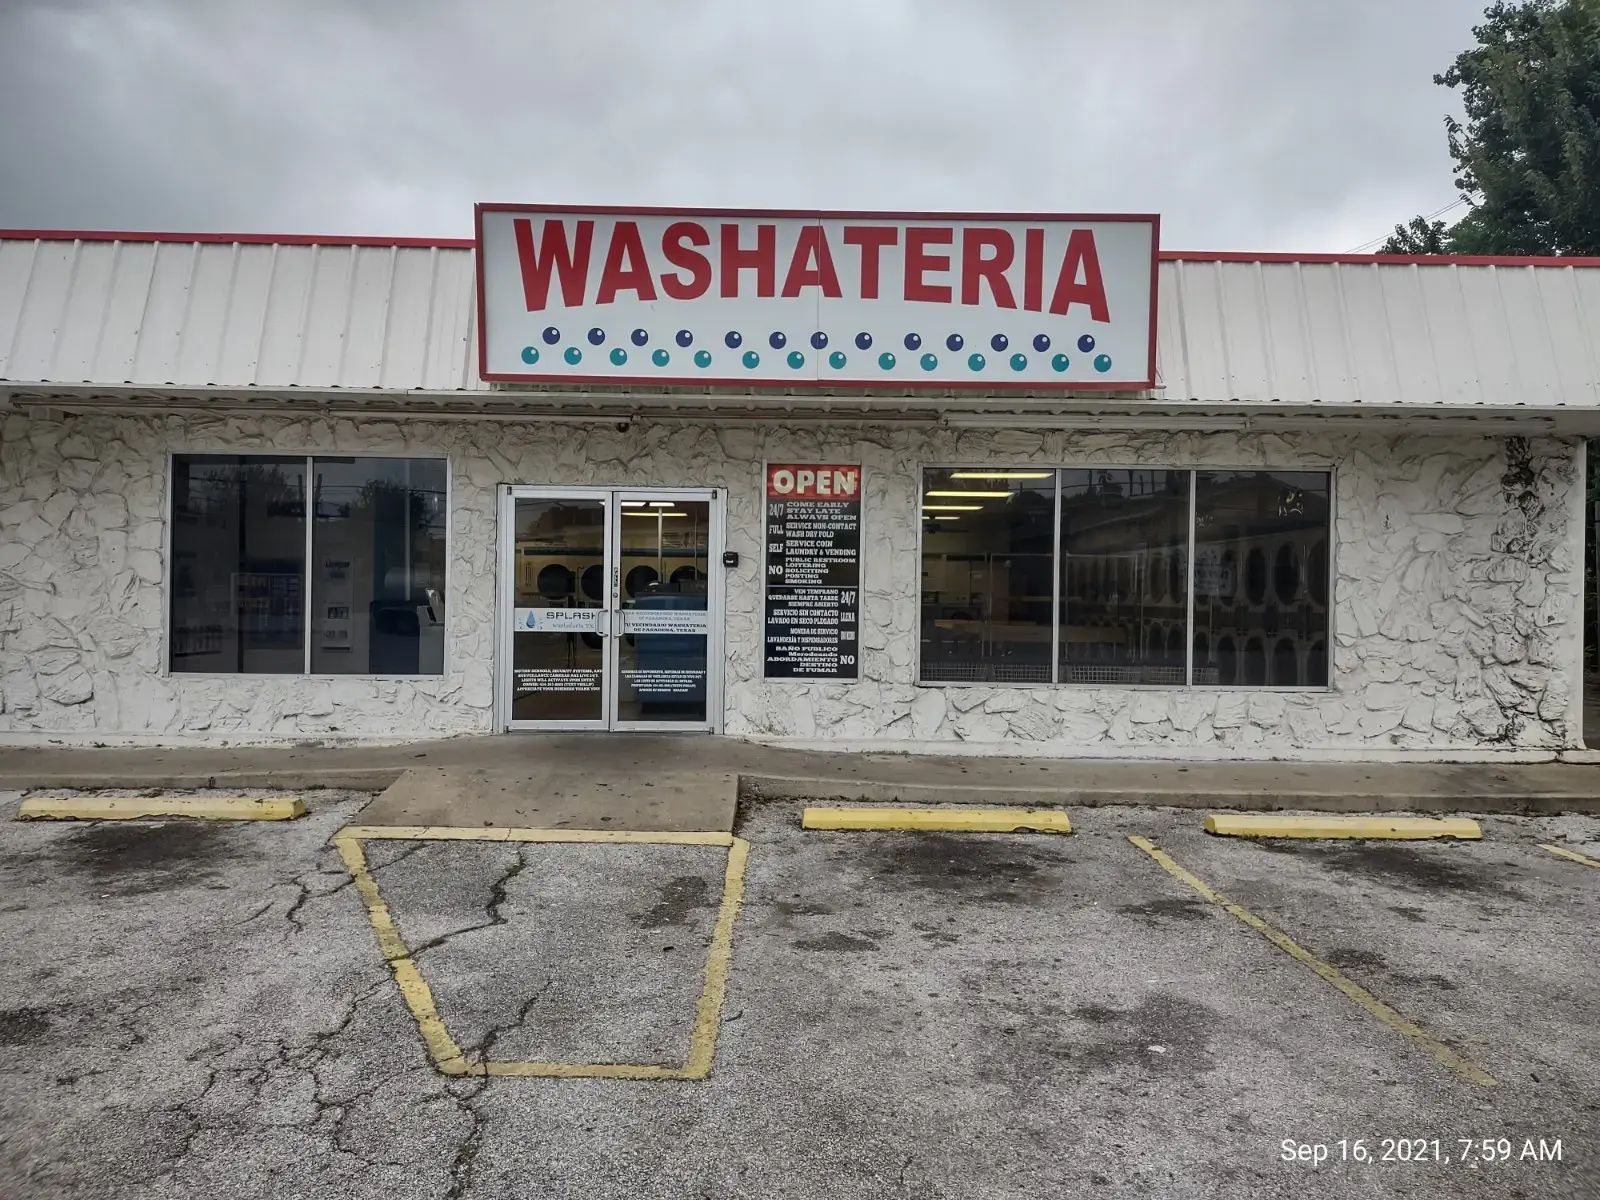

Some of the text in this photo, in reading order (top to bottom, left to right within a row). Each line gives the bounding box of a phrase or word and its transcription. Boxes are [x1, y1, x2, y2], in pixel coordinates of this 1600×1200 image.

[514, 218, 1110, 323] WASHATERIA
[773, 470, 854, 494] OPEN
[769, 504, 784, 517] 24/7
[769, 525, 783, 534] FULL
[769, 544, 783, 552] SELF
[768, 566, 783, 574] NO
[841, 591, 856, 606] 24/7
[840, 655, 855, 664] NO
